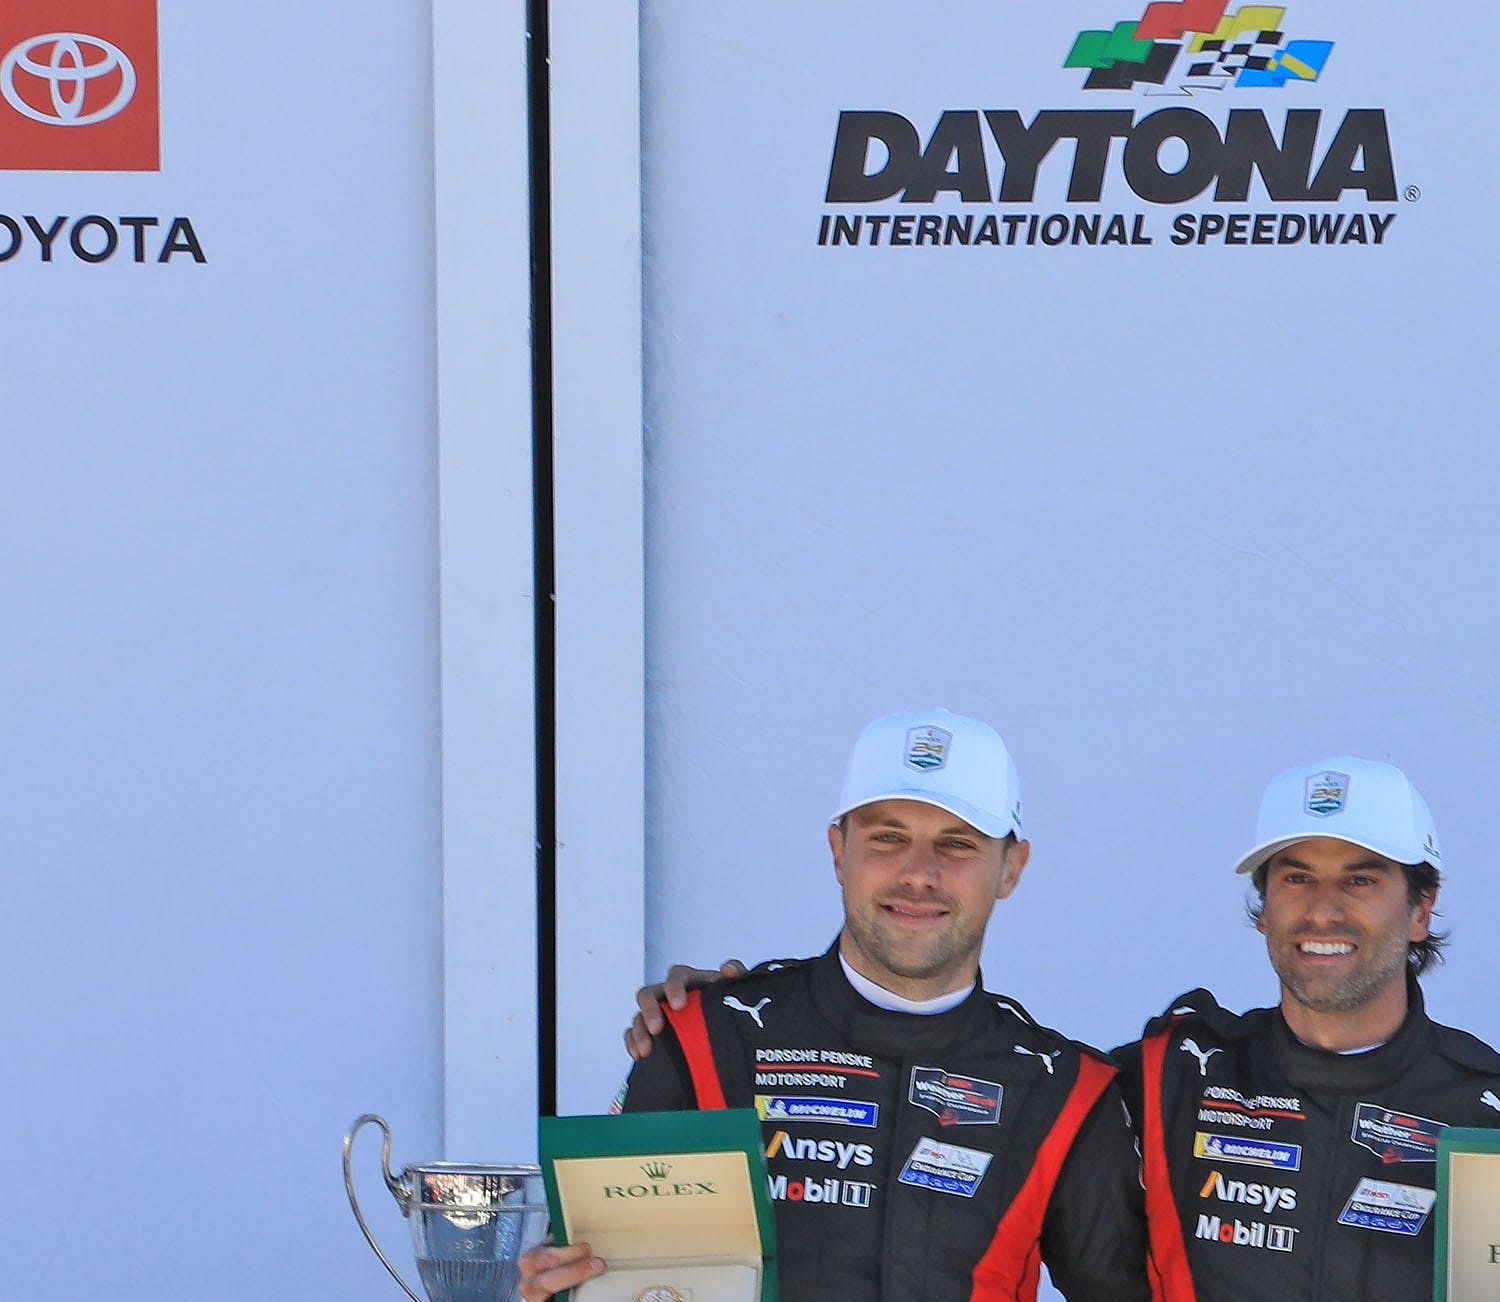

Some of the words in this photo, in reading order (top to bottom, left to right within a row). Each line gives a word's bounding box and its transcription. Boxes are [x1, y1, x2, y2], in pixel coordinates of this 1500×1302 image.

[824, 107, 1400, 205] DAYTONA
[817, 213, 1153, 246] INTERNATIONAL
[1170, 213, 1397, 246] SPEEDWAY
[756, 1048, 819, 1064] PORSCHE
[820, 1050, 874, 1069] PENSKE
[755, 1072, 848, 1090] MOTORSPORT
[1197, 1107, 1275, 1131] MOTORSPORT
[1256, 1094, 1301, 1112] PENSKE
[765, 1130, 875, 1171] Ansys
[602, 1180, 721, 1199] ROLEX
[768, 1173, 839, 1205] Mobil
[1199, 1169, 1298, 1214] Ansys
[1195, 1213, 1267, 1249] Mobil
